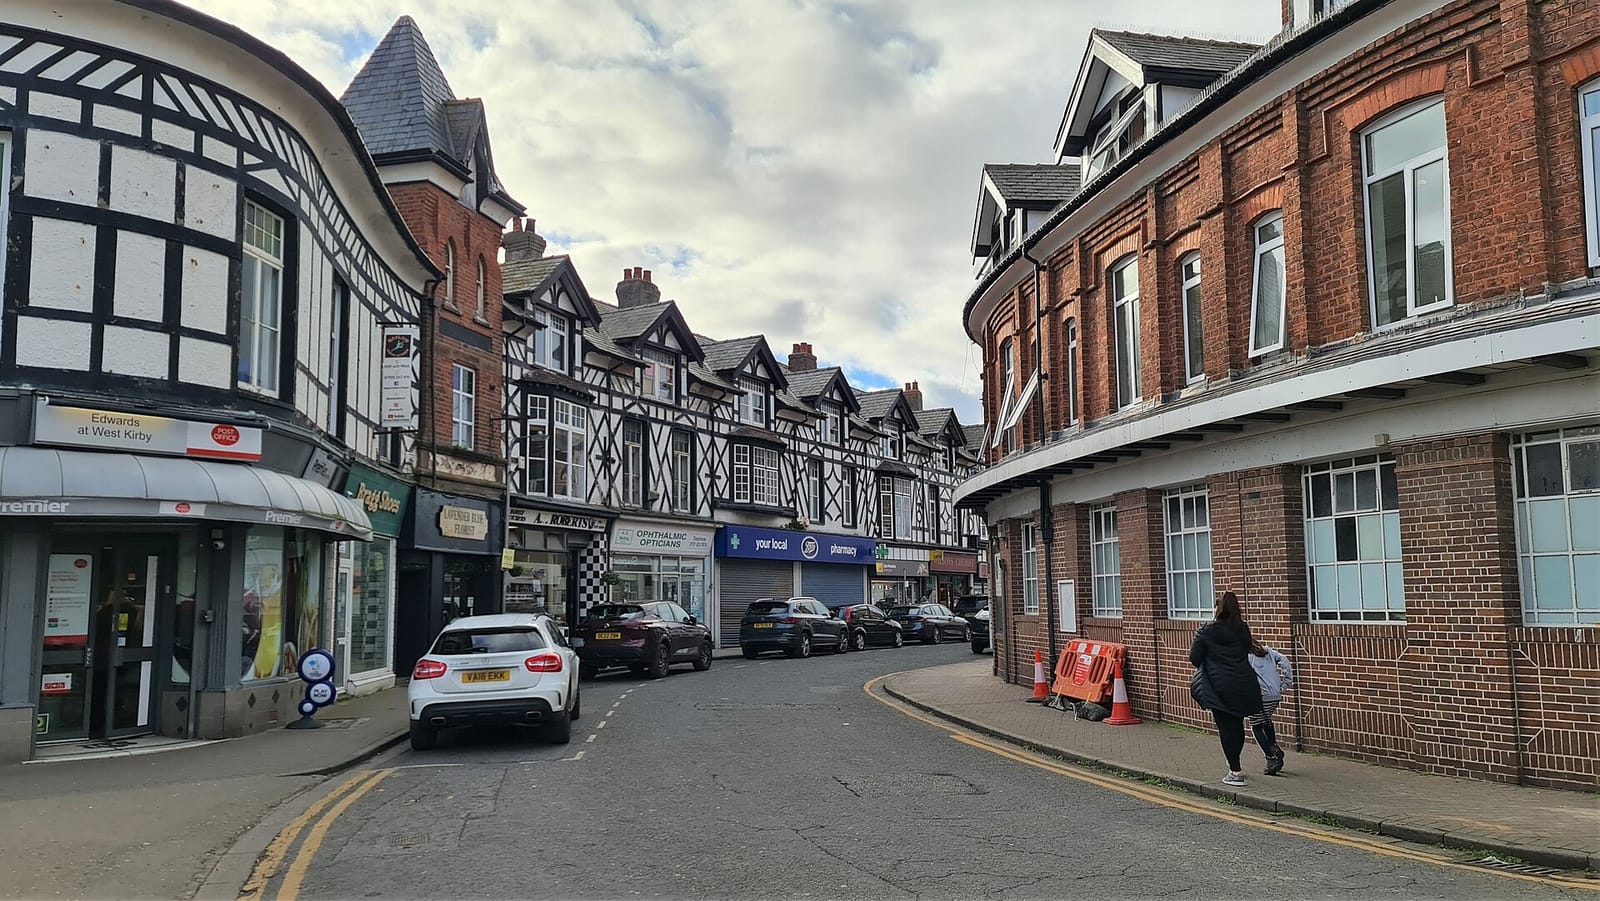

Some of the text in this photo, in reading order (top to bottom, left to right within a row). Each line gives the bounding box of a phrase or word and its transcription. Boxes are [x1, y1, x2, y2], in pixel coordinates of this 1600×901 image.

[91, 413, 140, 427] Edwards
[77, 426, 152, 444] at West Kirby
[213, 433, 237, 442] OFFICE
[217, 427, 236, 436] POST
[357, 482, 400, 513] Bragg Shoes
[0, 500, 70, 513] remier
[264, 510, 303, 524] Premier
[444, 509, 471, 521] LAVENDER
[550, 514, 589, 529] ROBERTS
[454, 523, 476, 536] FLORIST
[636, 529, 688, 541] OPHTHALMIC
[639, 538, 681, 548] OPTICIANS
[755, 537, 788, 550] your local
[830, 543, 857, 557] pharmacy
[467, 670, 505, 682] VA18 EKK
